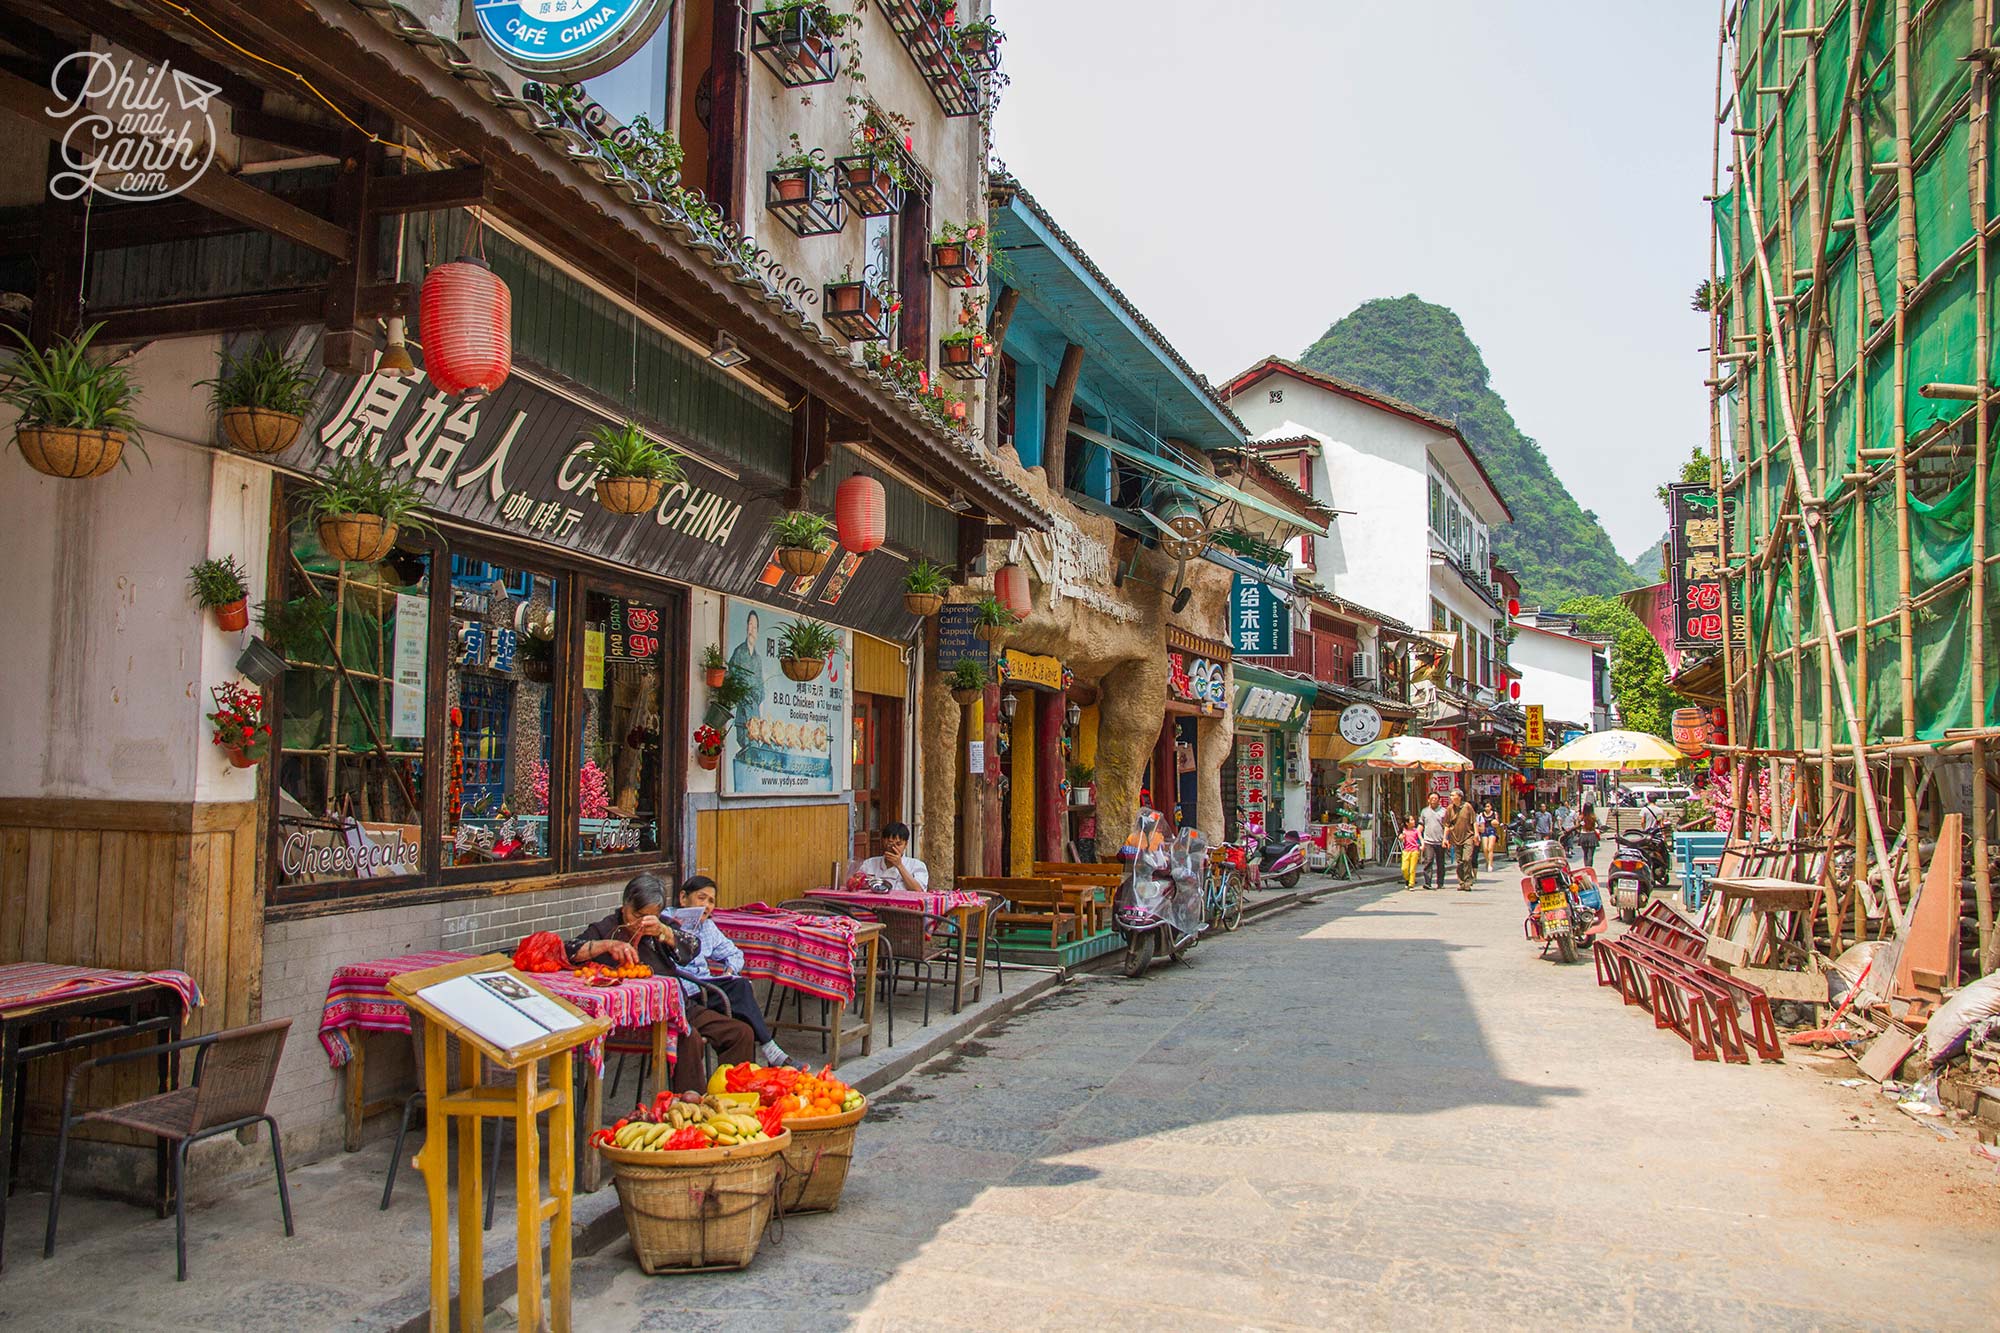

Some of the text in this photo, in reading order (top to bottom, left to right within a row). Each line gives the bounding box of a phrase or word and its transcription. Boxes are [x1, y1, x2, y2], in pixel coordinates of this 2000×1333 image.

[539, 0, 583, 15] 原始人
[505, 6, 616, 46] CAFÉ CHINA
[321, 348, 528, 502] 原始人
[501, 492, 584, 538] 咖啡厅
[656, 481, 743, 547] CHINA
[940, 605, 974, 614] Espresso
[1272, 619, 1279, 628] to
[940, 627, 974, 637] Cappucc
[940, 638, 966, 646] Mocha
[939, 649, 988, 657] Irish Coffee
[792, 695, 815, 709] Chicken
[789, 708, 828, 724] Booking Required
[600, 818, 642, 850] Coffee
[282, 828, 419, 876] Cheesecake
